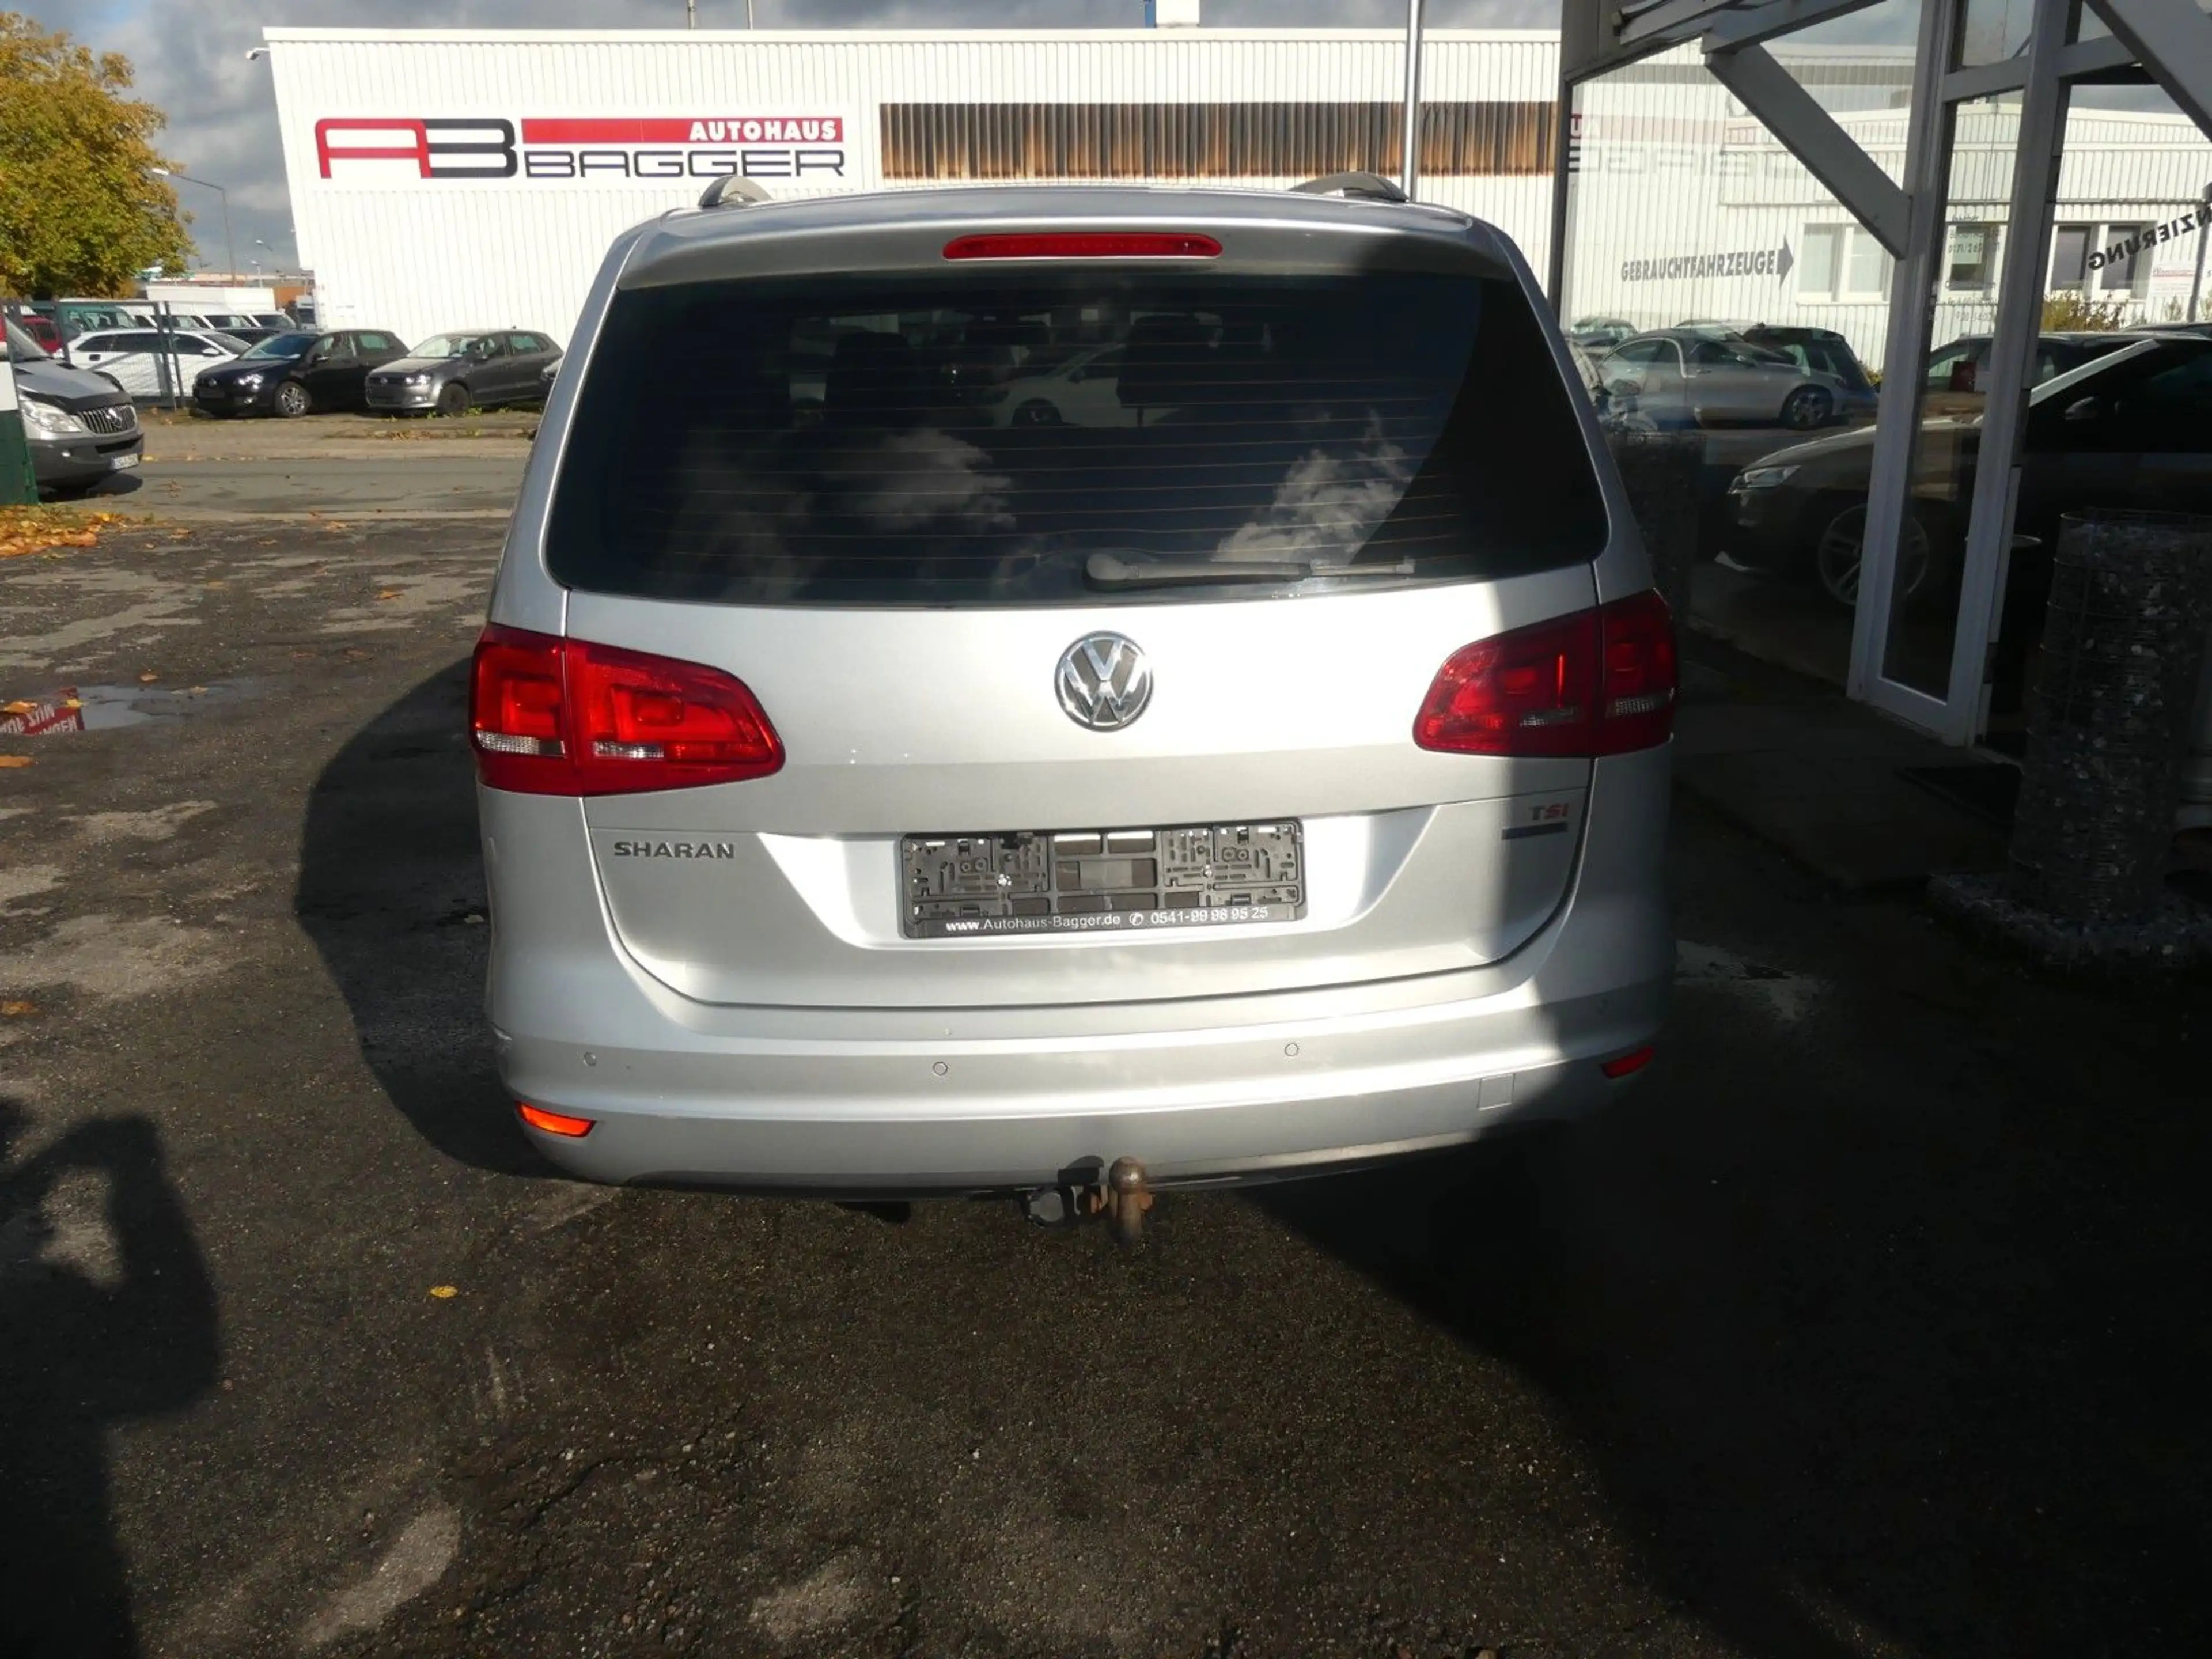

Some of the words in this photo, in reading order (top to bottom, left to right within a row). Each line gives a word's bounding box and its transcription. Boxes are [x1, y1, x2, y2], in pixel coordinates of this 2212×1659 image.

[688, 119, 837, 142] AUTOHAUS
[315, 118, 518, 178] AB
[524, 149, 846, 177] BAGGER
[1621, 250, 1775, 282] GEBRAUCHTFAHRZEUGE
[613, 841, 734, 858] SHARAN
[945, 914, 1121, 931] www.Autohaus-Bagger.de
[1251, 906, 1268, 919] 25
